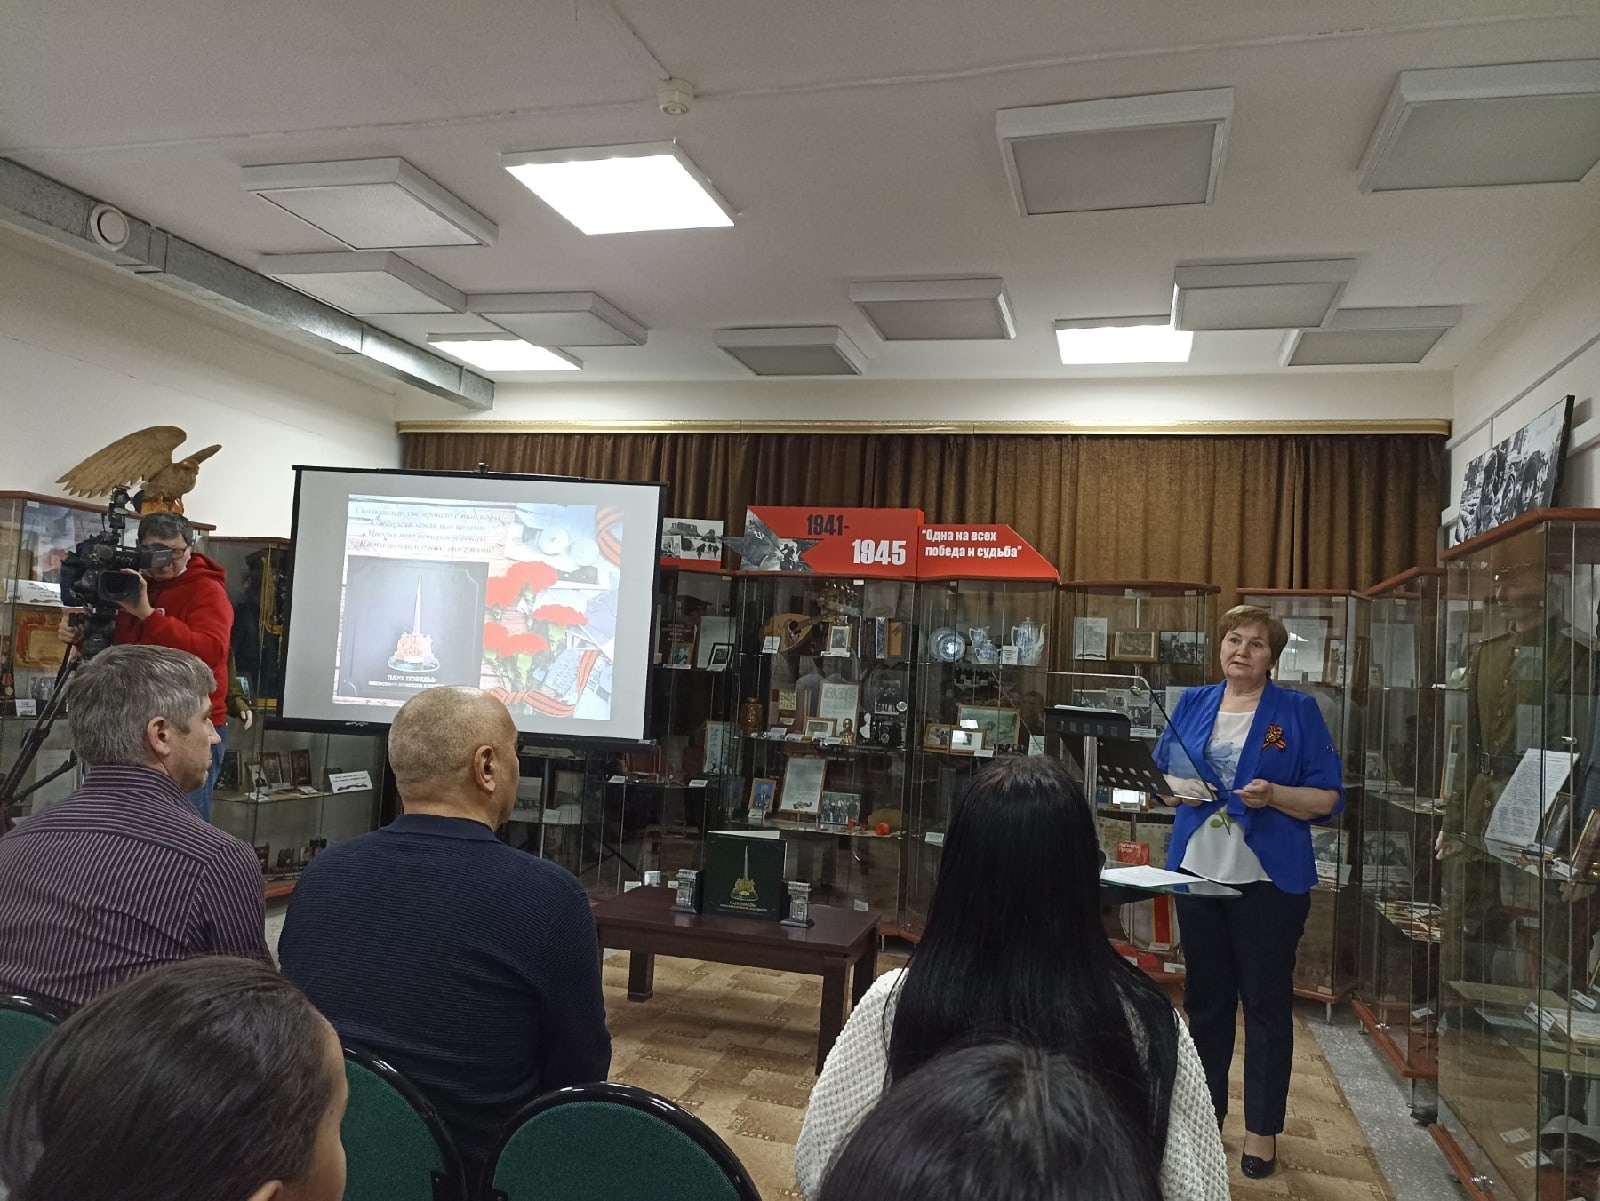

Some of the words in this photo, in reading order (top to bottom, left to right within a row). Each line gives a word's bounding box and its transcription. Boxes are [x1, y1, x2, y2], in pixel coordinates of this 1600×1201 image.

[807, 514, 850, 536] 1941-
[955, 531, 969, 541] на
[971, 531, 997, 541] всех
[852, 538, 907, 565] 1945
[925, 545, 965, 558] победа
[967, 547, 975, 557] и
[977, 545, 1022, 559] судьба"
